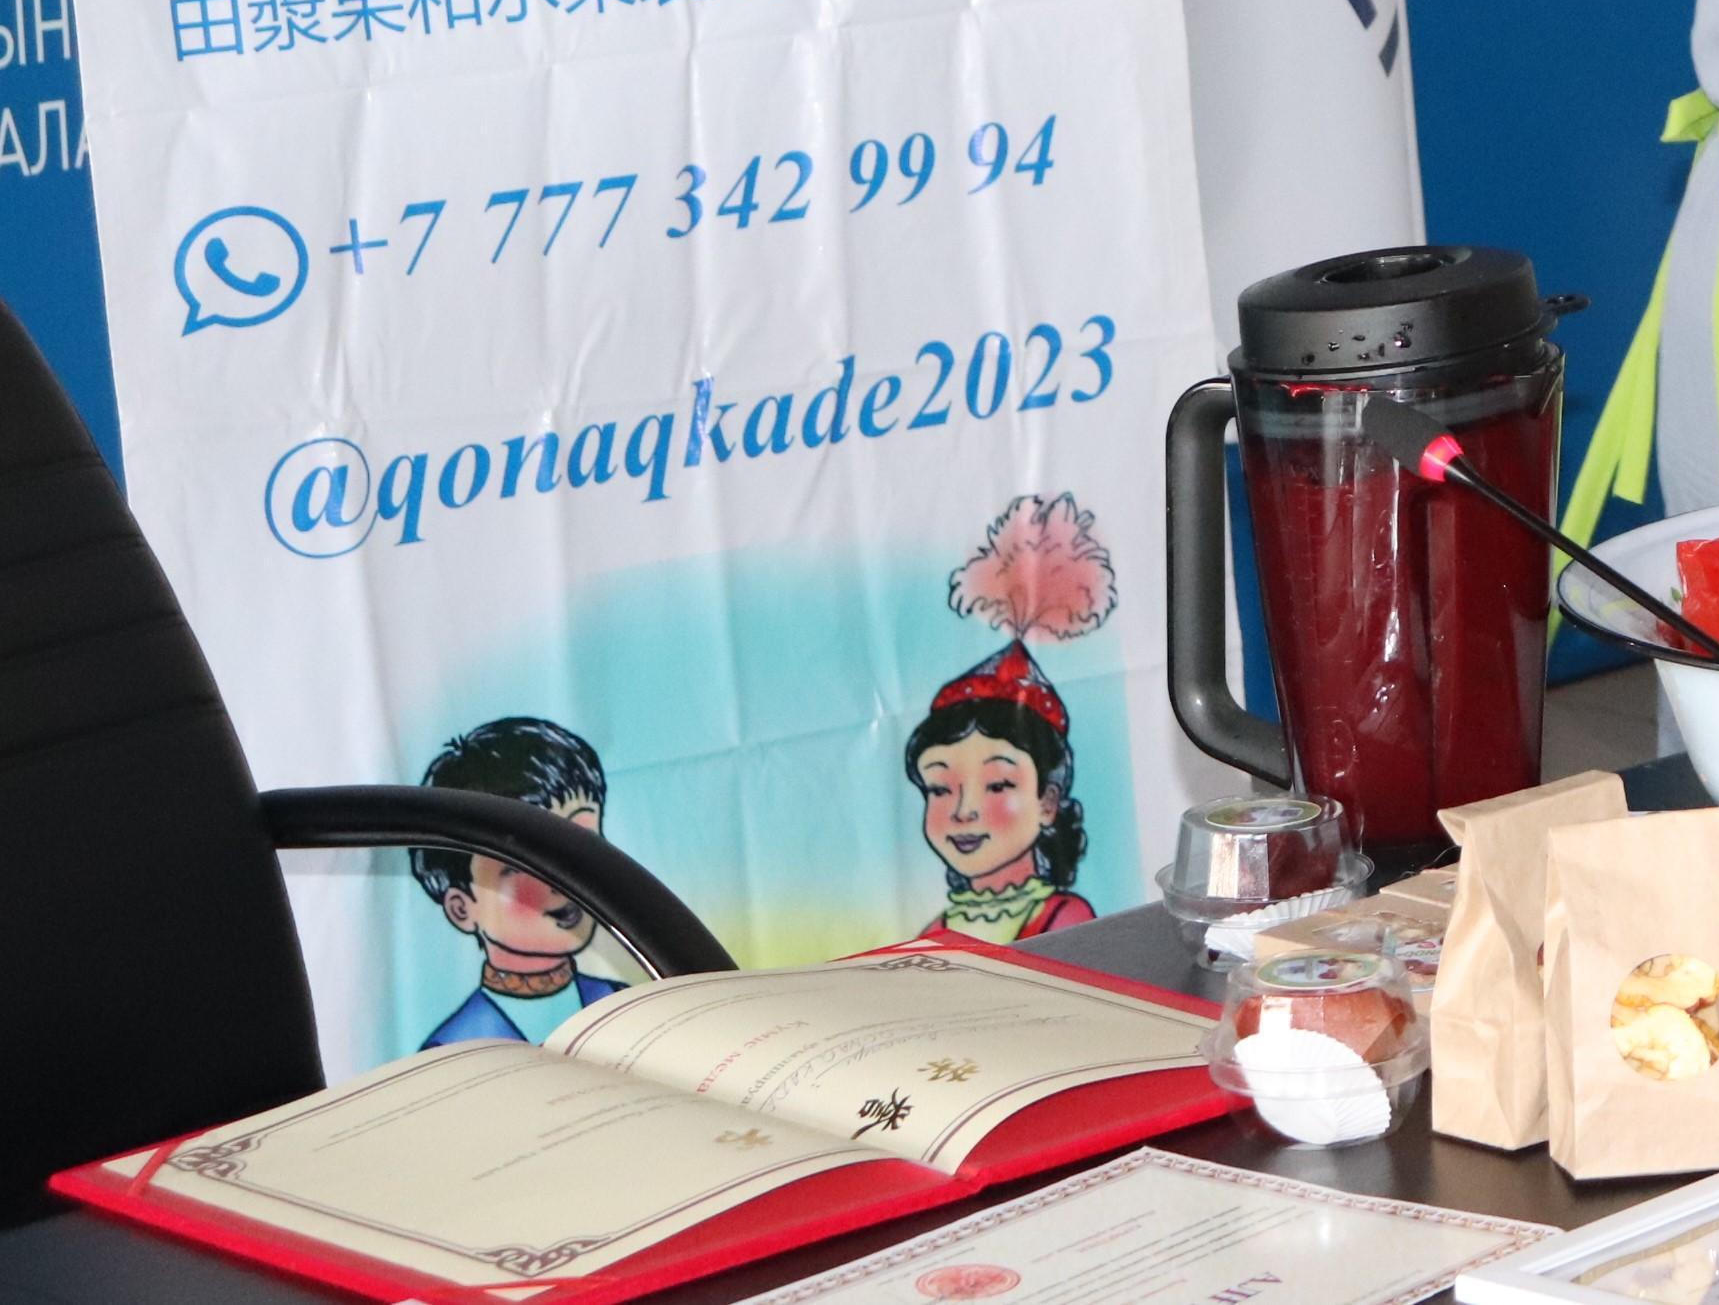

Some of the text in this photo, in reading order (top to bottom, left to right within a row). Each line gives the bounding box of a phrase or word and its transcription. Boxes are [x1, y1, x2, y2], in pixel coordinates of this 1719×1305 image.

[329, 113, 1057, 276] +7 777 342 99 94
[263, 312, 1118, 560] @qonaqkade2023
